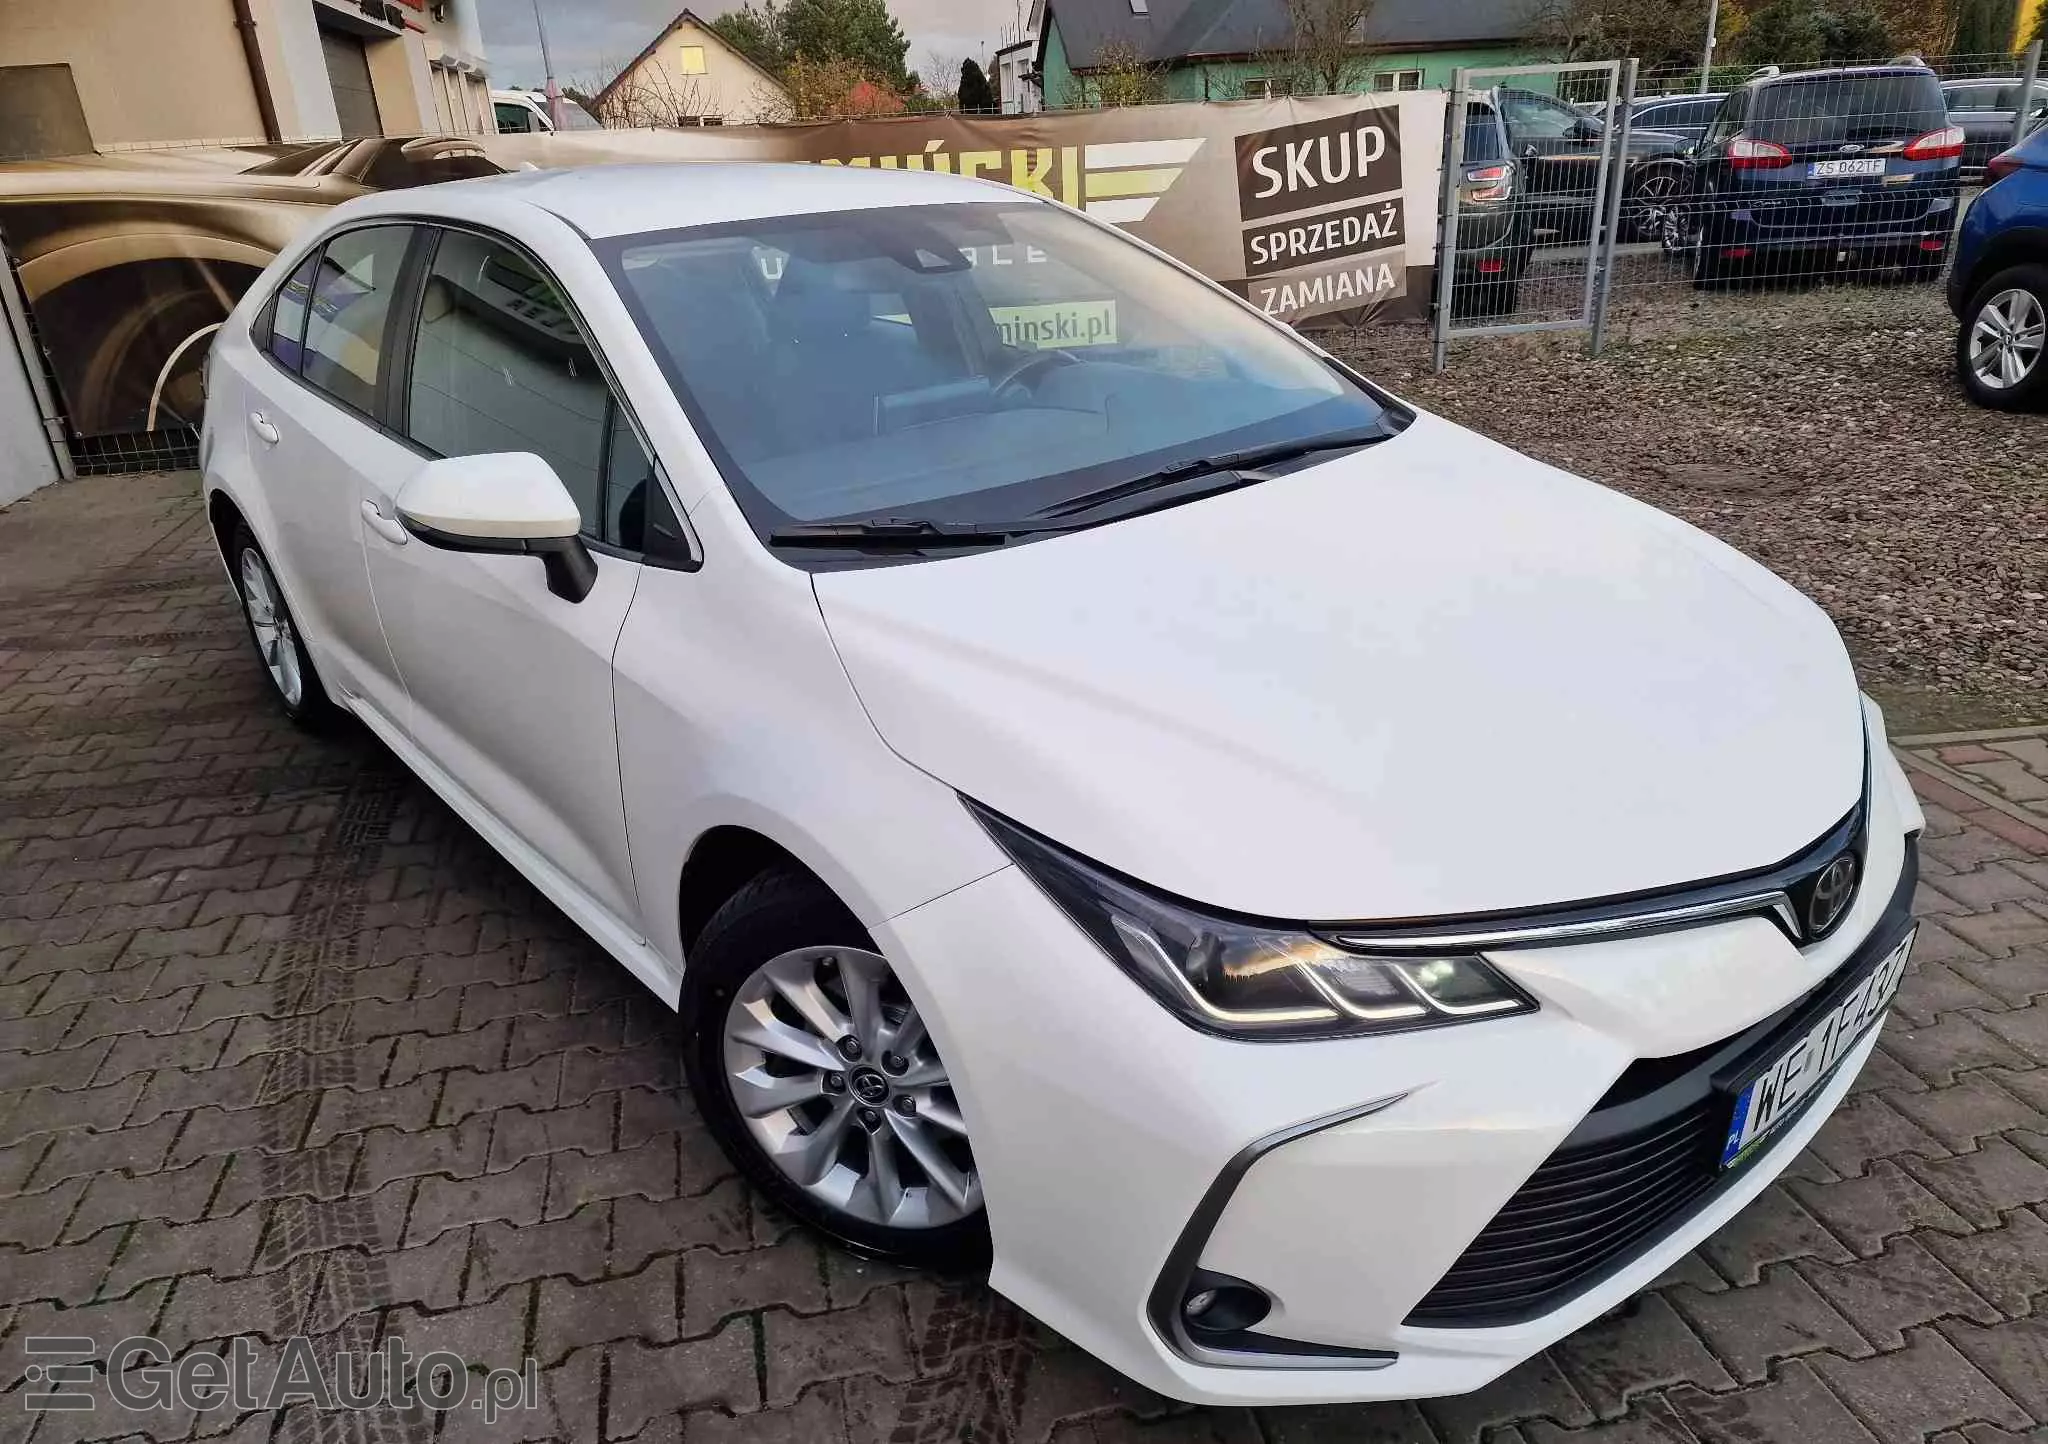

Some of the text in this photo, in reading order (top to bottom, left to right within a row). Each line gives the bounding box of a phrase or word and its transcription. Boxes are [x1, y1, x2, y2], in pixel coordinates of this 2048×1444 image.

[1252, 125, 1386, 199] SKUP
[1816, 160, 1881, 175] ZS 062TF
[1250, 202, 1398, 265] SPRZEDAŻ
[1260, 263, 1396, 315] ZAMIANA
[1753, 941, 1908, 1132] WE 1F437
